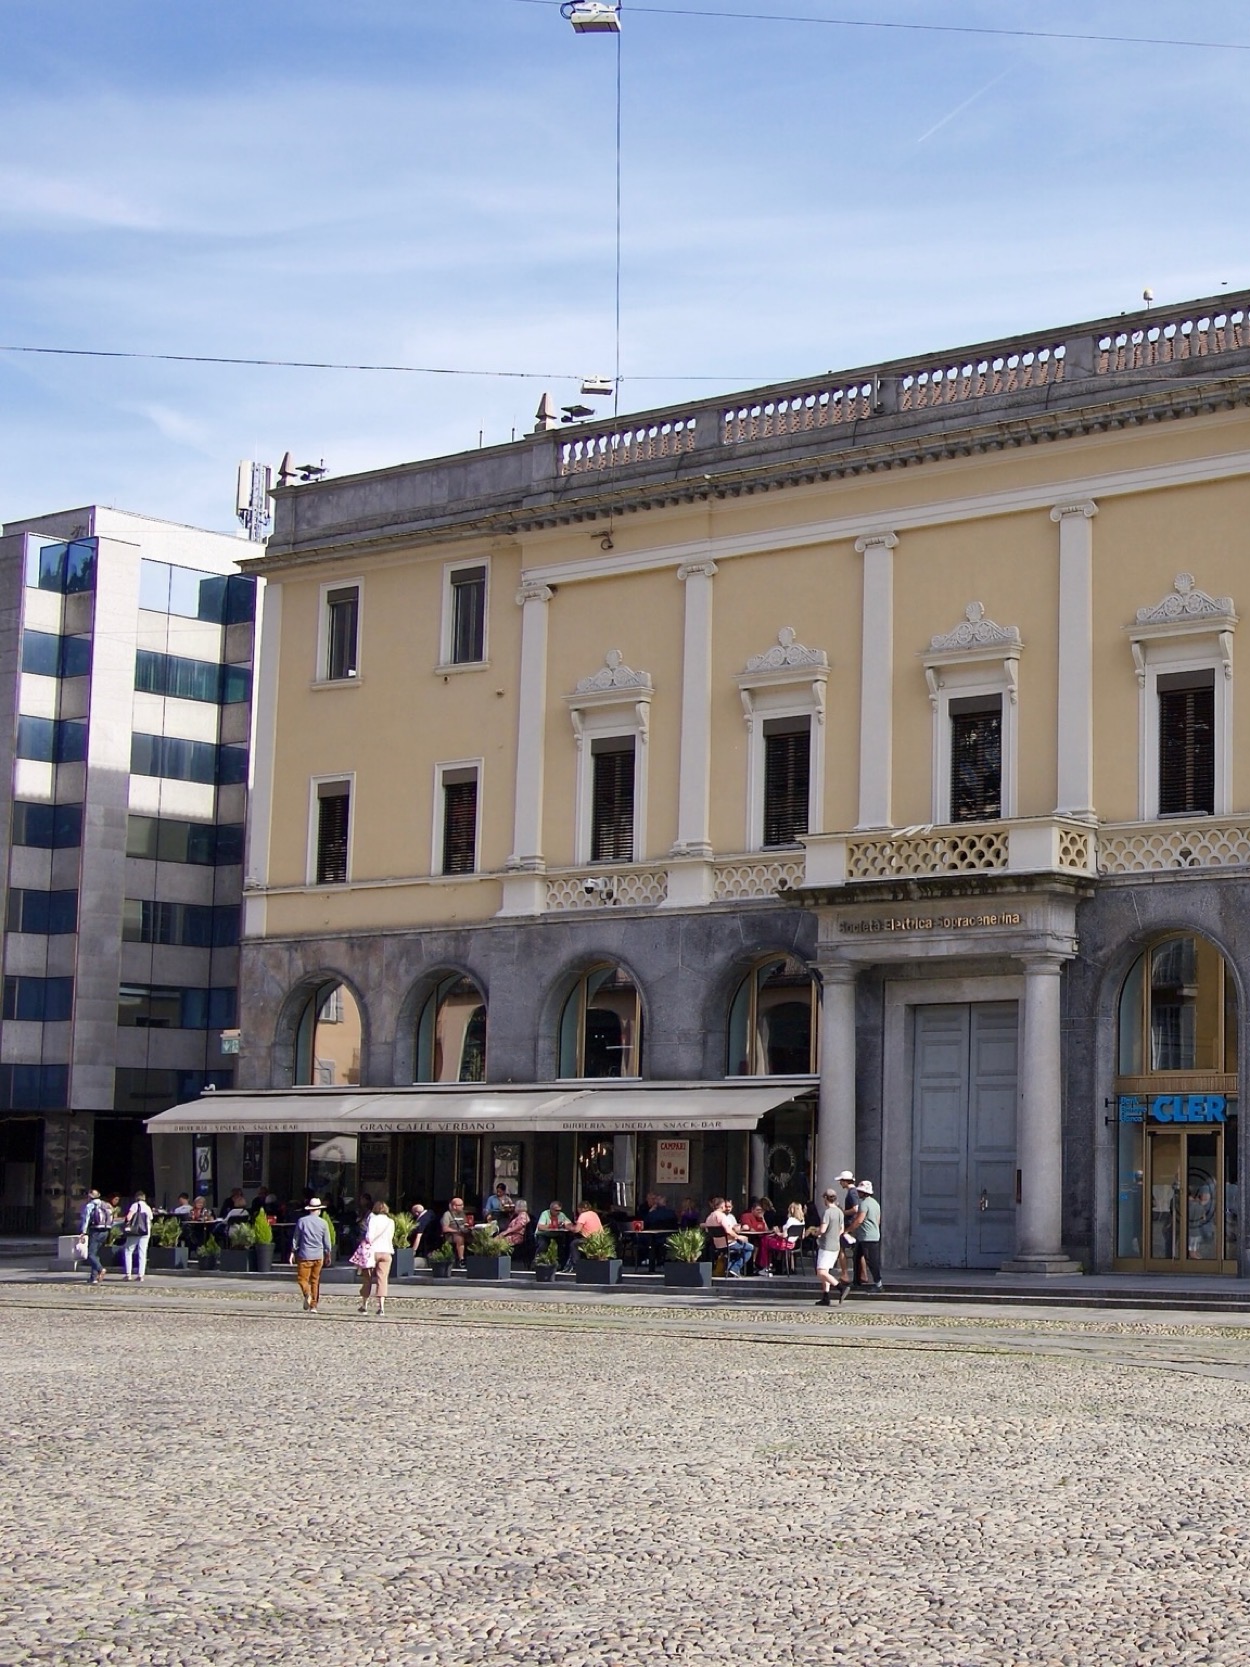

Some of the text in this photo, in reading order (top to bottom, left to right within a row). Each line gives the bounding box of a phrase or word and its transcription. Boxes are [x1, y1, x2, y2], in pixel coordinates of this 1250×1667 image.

[884, 917, 933, 931] Elettrica
[1152, 1095, 1227, 1122] CLER
[360, 1123, 392, 1131] GRAN
[438, 1122, 495, 1131] VERBANO
[660, 1142, 686, 1150] CAMPARI
